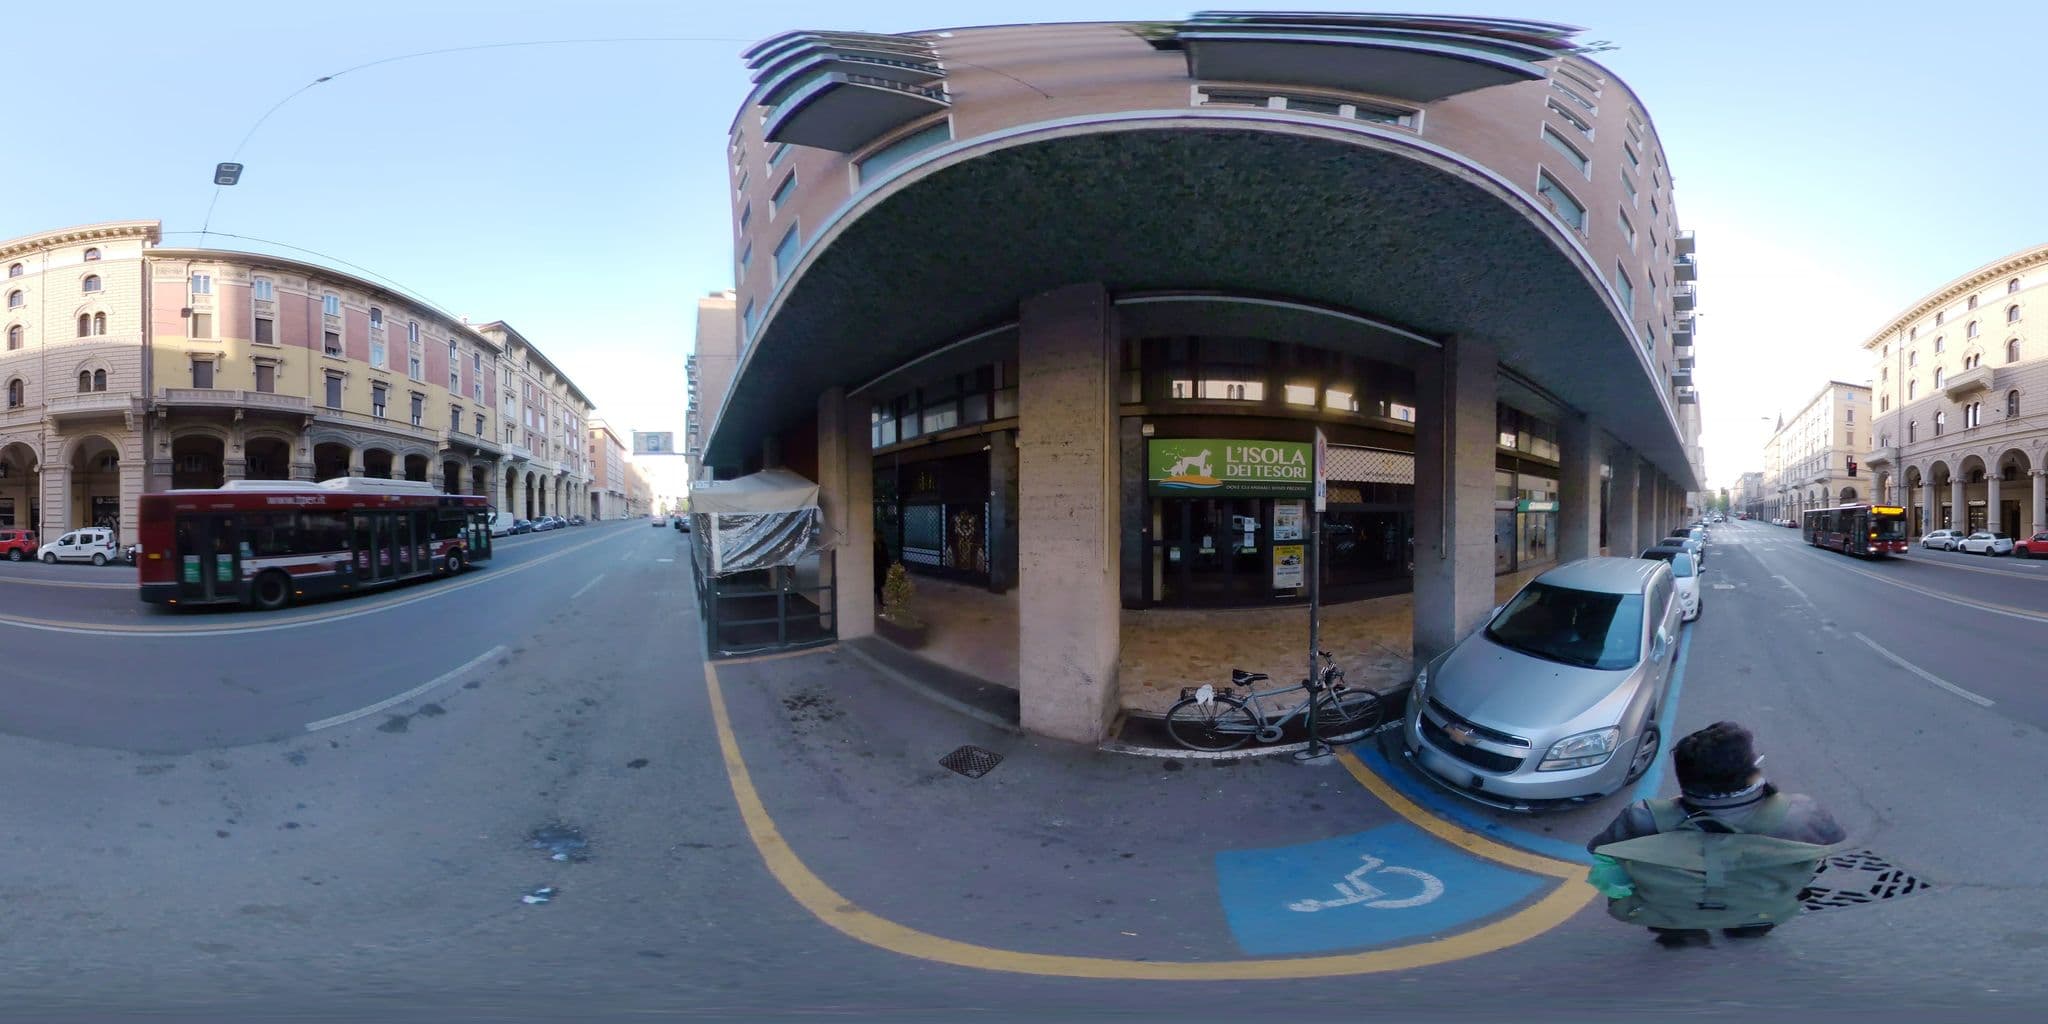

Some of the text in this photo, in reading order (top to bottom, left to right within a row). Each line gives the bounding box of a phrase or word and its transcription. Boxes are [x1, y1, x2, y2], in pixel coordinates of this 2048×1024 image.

[1226, 446, 1306, 466] L'ISOLA
[1226, 464, 1306, 478] DEI TESORI
